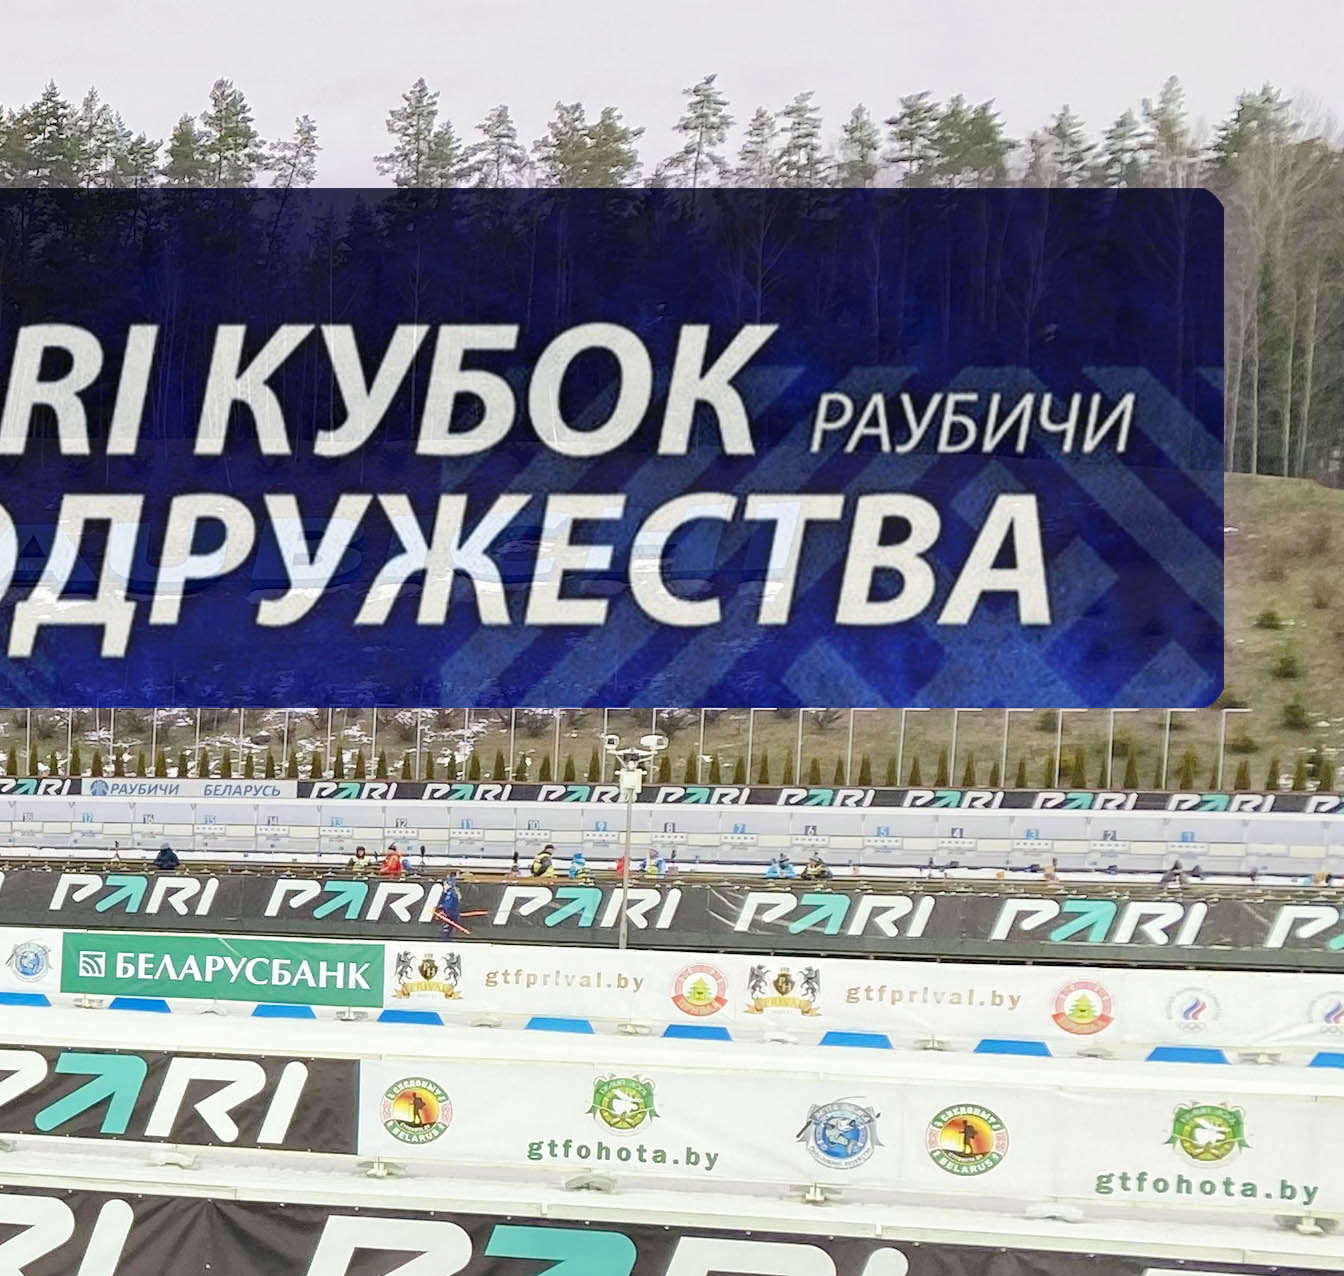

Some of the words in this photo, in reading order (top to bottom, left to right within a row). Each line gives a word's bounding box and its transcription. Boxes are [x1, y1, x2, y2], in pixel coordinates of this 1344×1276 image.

[110, 781, 179, 797] РАУБИЧИ
[204, 784, 281, 798] БЕЛАРУСЬ
[310, 782, 397, 799] PARI
[422, 783, 512, 801] PARI
[655, 786, 749, 804] PARI
[778, 788, 875, 807] PARI
[902, 790, 1004, 809] PARI
[1032, 792, 1137, 810] PARI
[1167, 794, 1275, 812] PARI
[50, 874, 220, 916] PARI
[264, 877, 443, 923] PARI
[493, 885, 683, 929] PARI
[733, 891, 936, 938] PARI
[990, 898, 1208, 945] PARI
[116, 952, 371, 990] БЕЛАРУСБАНК
[485, 968, 644, 993] gtfprival.by
[846, 985, 1022, 1011] gtfprival.by
[391, 1124, 440, 1142] BELARUS
[526, 1139, 720, 1171] gtfohota.by
[938, 1151, 994, 1174] BELARUS
[1094, 1171, 1319, 1205] gtfohota.by
